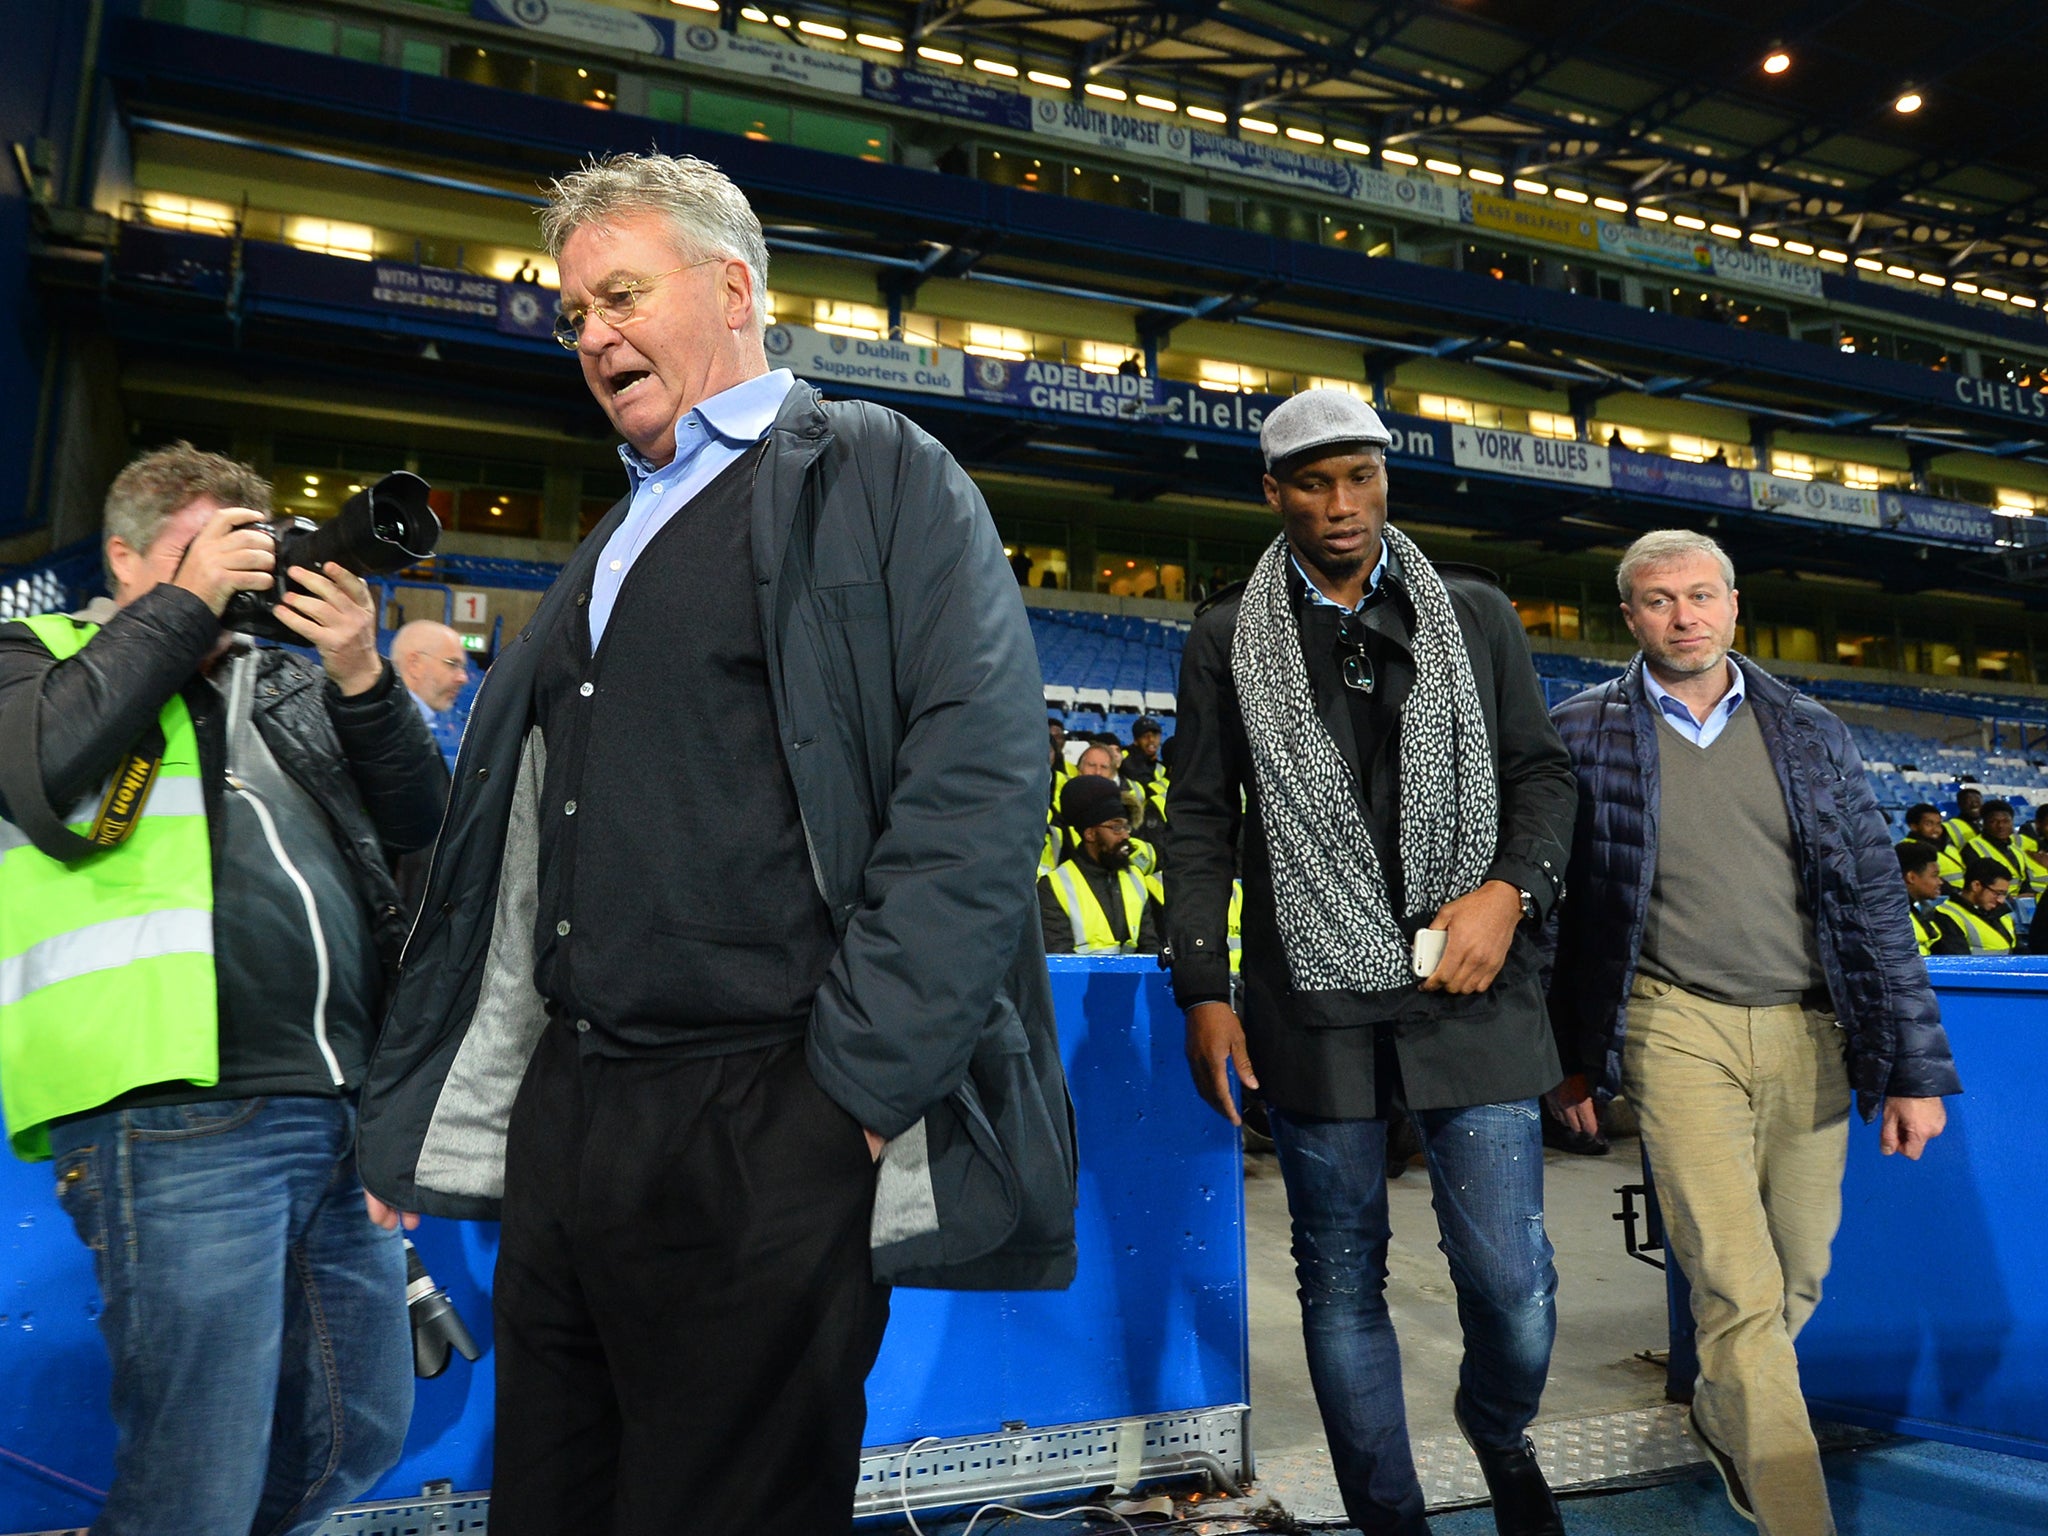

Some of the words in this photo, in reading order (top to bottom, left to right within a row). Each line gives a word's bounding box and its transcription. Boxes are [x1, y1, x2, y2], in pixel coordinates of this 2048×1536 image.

[1063, 101, 1107, 138] SOUTH
[1111, 114, 1161, 146] DORSET
[1477, 202, 1511, 220] EAST
[1514, 210, 1571, 234] BELFAST
[376, 267, 419, 287] WITH
[420, 272, 455, 293] YOU
[1716, 246, 1774, 277] SOUTH
[1777, 259, 1823, 288] WEST
[856, 341, 911, 363] Dublin
[812, 355, 909, 384] Supporters
[914, 369, 952, 389] Club
[1025, 362, 1155, 400] ADELAIDE
[1956, 376, 2046, 418] CHELS
[1475, 430, 1525, 463] YORK
[1533, 440, 1589, 472] BLUES
[1829, 493, 1863, 515] BLUES
[1910, 511, 1994, 539] VANCOUVER
[466, 596, 477, 620] 1
[111, 756, 151, 815] Nikon
